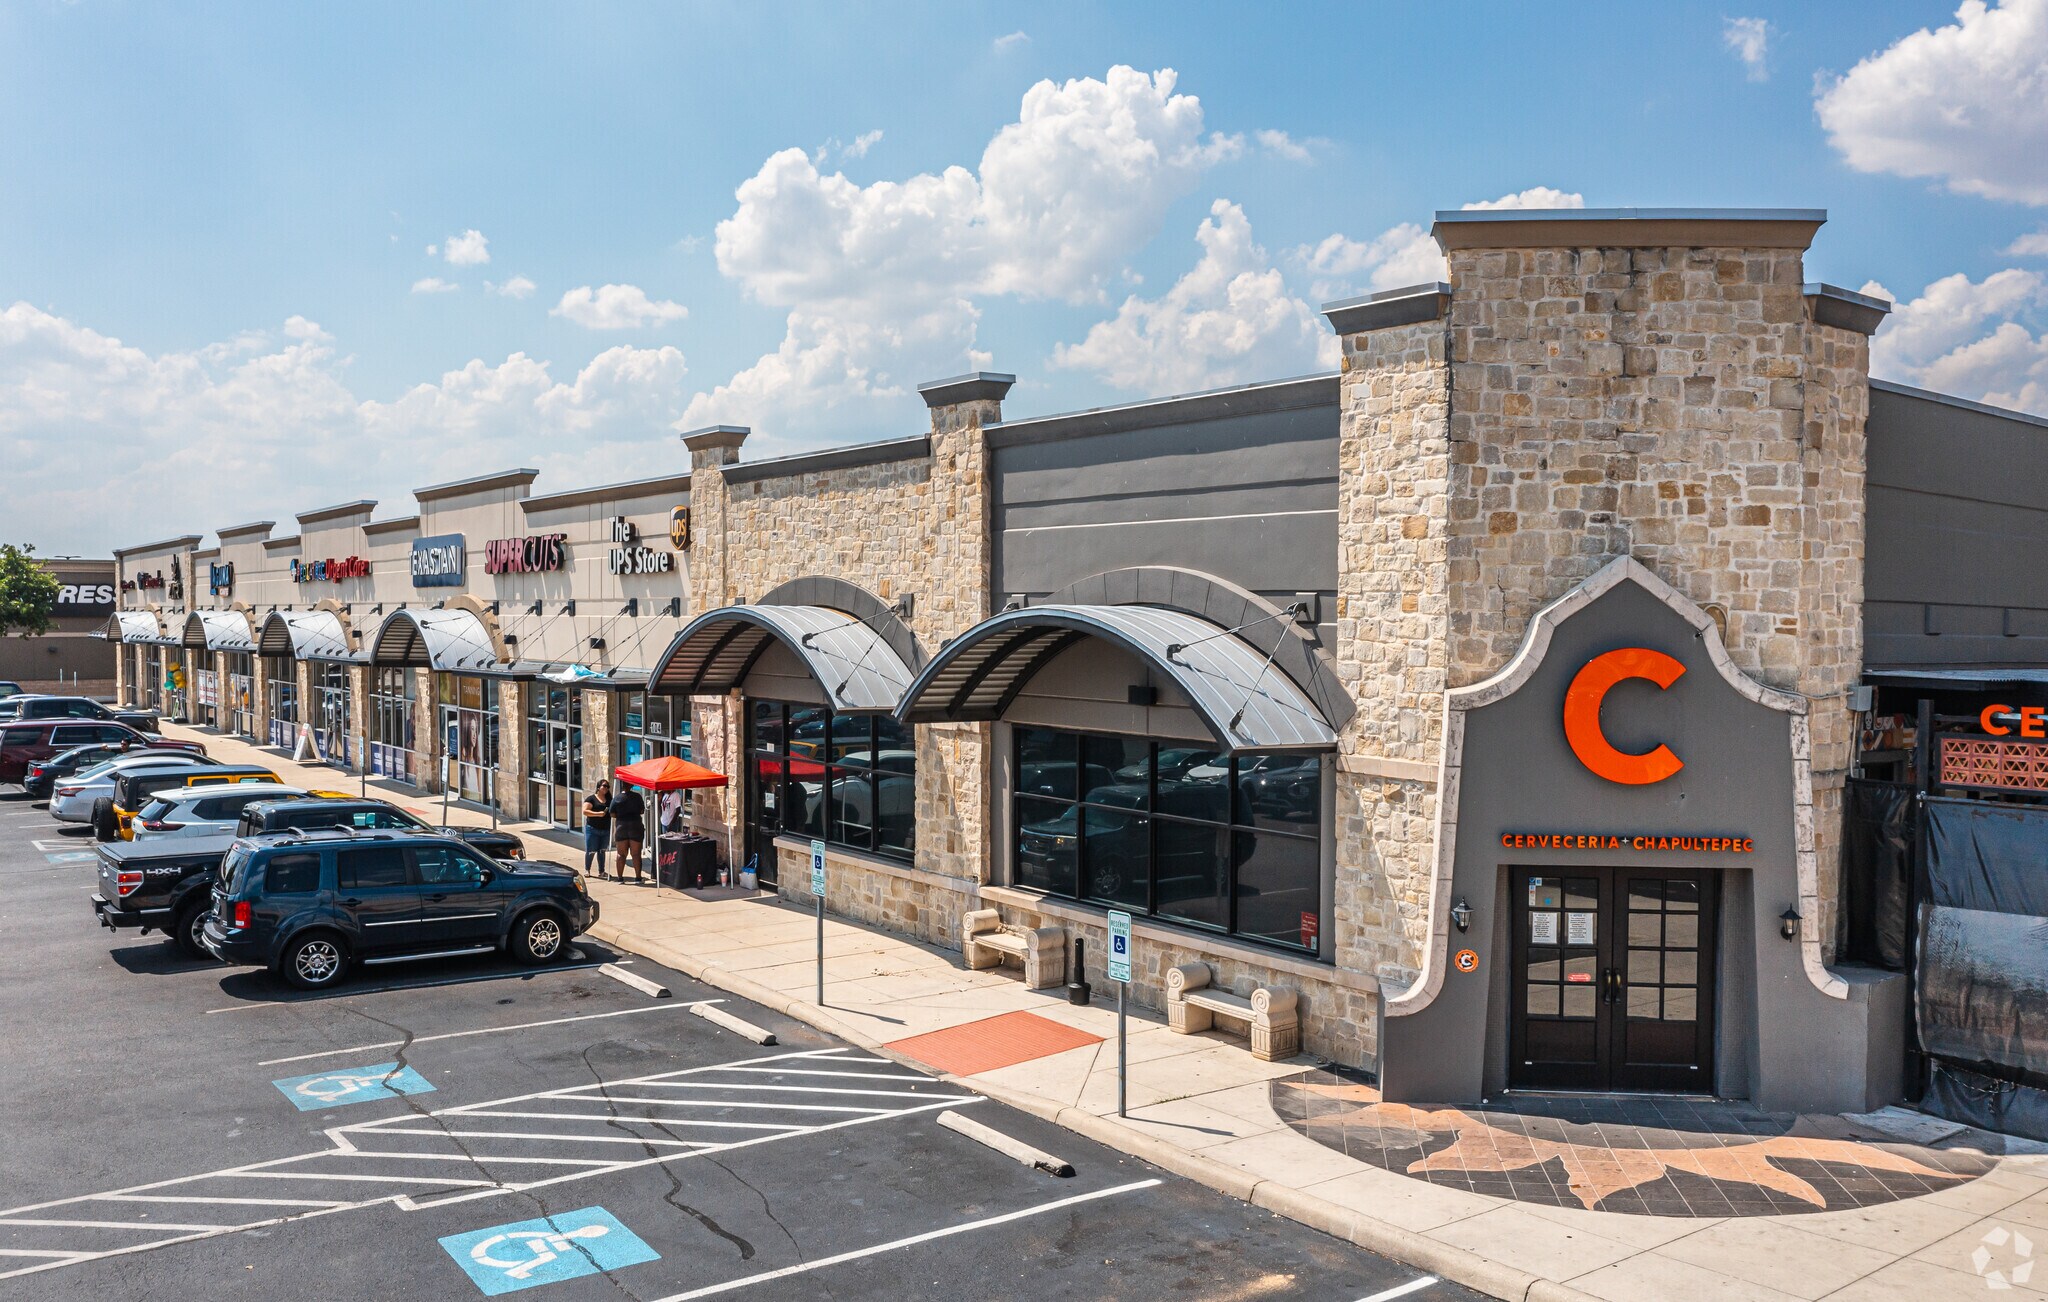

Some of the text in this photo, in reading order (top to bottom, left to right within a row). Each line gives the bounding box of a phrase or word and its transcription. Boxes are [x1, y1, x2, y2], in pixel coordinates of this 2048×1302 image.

[608, 515, 631, 542] The
[670, 518, 687, 544] ups
[348, 556, 368, 577] Care
[484, 533, 561, 575] SUPERCUTS
[608, 546, 669, 575] UPS Store
[57, 584, 117, 604] RES
[1563, 646, 1688, 786] C
[1980, 703, 2046, 738] CE
[1501, 833, 1754, 853] CERVECERIA CHAPULTEPEC
